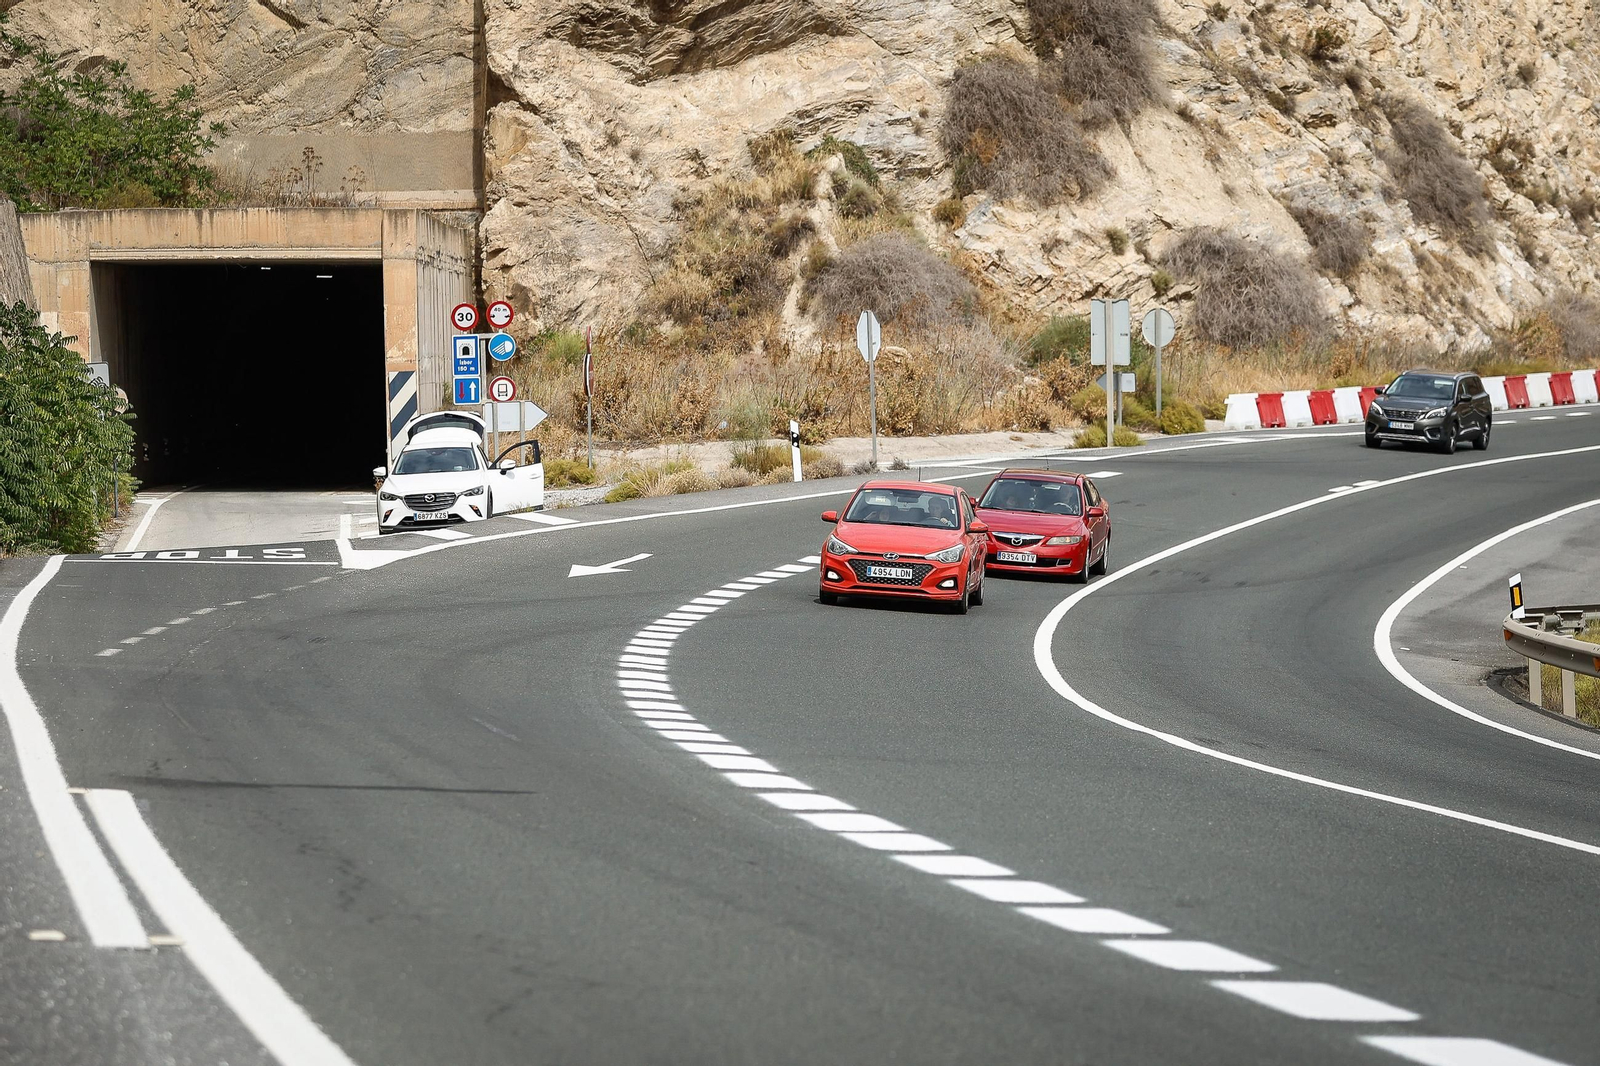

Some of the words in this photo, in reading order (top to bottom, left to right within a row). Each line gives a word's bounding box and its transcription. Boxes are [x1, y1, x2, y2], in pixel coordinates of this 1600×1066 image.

[457, 312, 473, 322] 30
[100, 548, 306, 560] STOP
[1002, 552, 1019, 560] 9354
[872, 568, 893, 576] 4954
[895, 569, 911, 577] LDN
